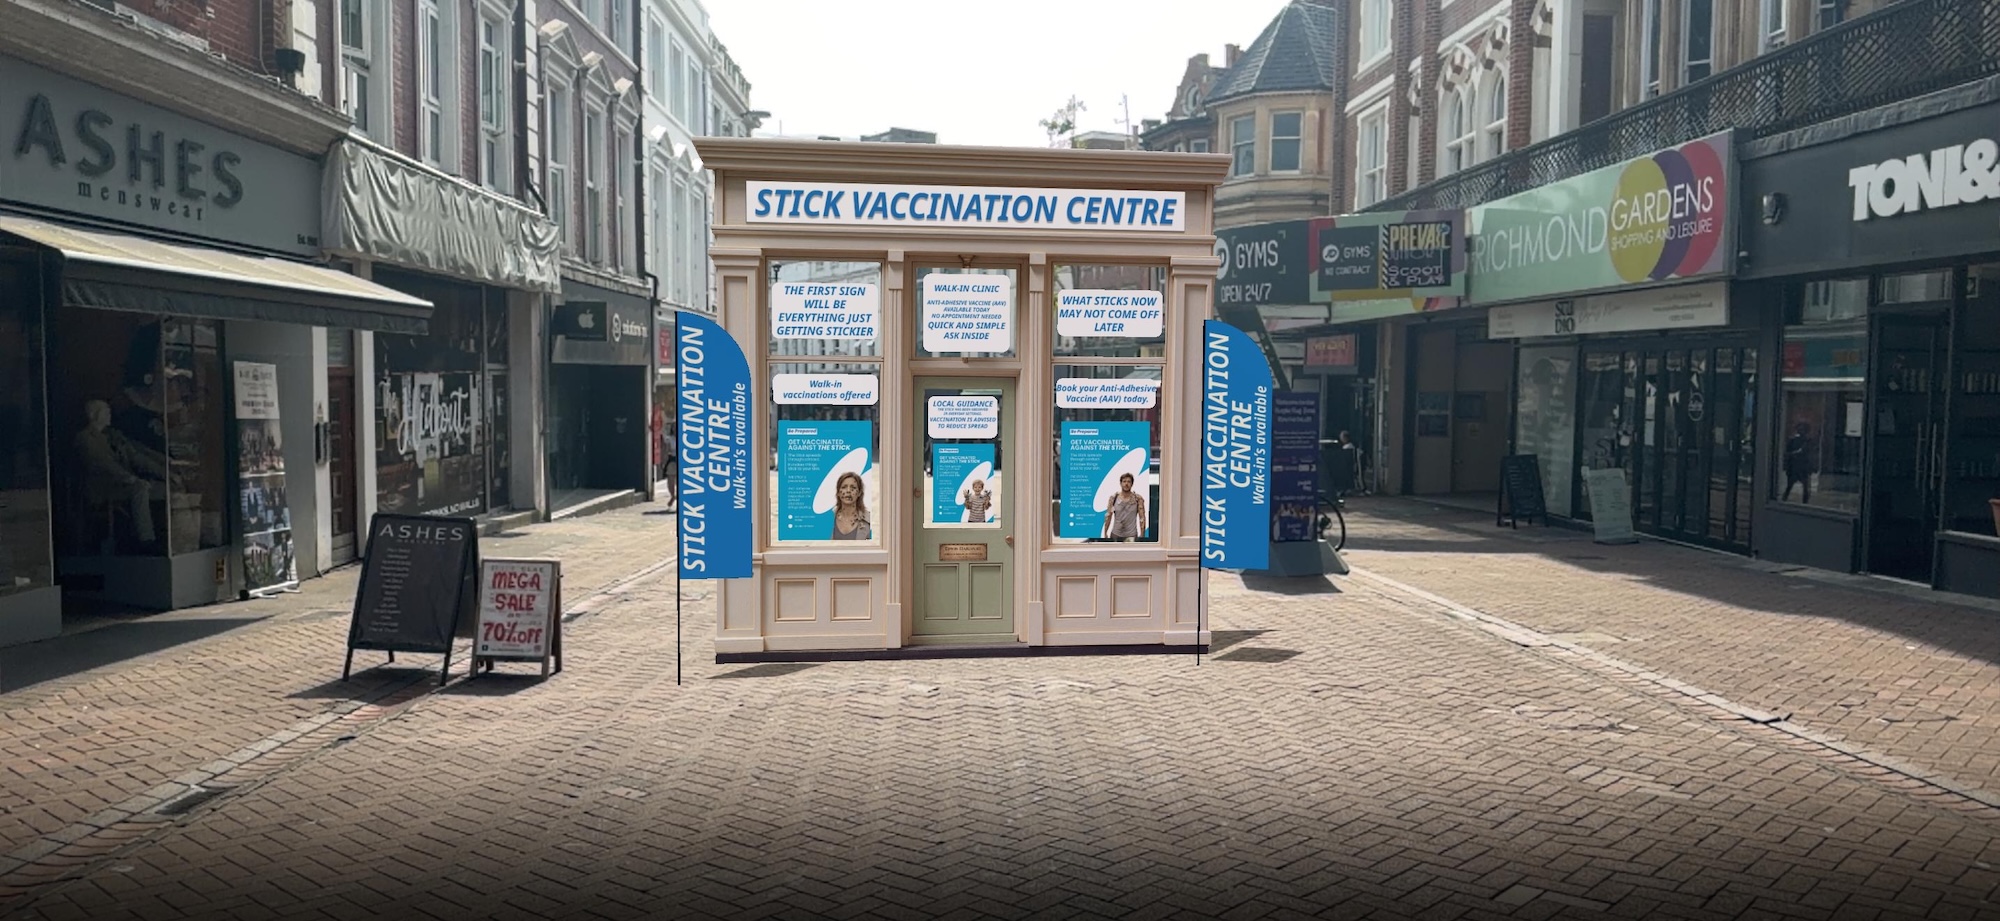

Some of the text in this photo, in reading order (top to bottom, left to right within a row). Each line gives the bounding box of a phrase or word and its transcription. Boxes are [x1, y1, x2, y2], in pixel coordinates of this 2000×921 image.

[14, 91, 244, 208] ASHES
[1849, 138, 2000, 221] TONI&
[78, 180, 203, 221] menswear
[755, 188, 1178, 226] STICK VACCINATION CENTRE
[1611, 176, 1713, 231] GARDENS
[1473, 206, 1607, 274] RICHMOND
[1611, 218, 1713, 251] SHOPPING AND LEISURE
[1235, 240, 1279, 269] GYMS
[1343, 245, 1371, 260] GYMS
[1325, 265, 1371, 276] NO CONTRACT
[934, 284, 1000, 293] WALK-IN CLINIC
[1388, 276, 1400, 286] &
[784, 286, 866, 296] THE FIRST SIGN
[1220, 283, 1272, 303] OPEN 24/7
[804, 300, 846, 309] WILL BE
[1062, 296, 1157, 306] WHAT STICKS NOW
[778, 313, 872, 324] EVERYTHING JUST
[1059, 309, 1160, 319] MAY NOT COME OFF
[777, 326, 874, 336] GETTING STICKIER
[928, 321, 954, 330] QUICK
[955, 321, 974, 329] AND
[1094, 323, 1124, 332] LATER
[809, 380, 842, 388] Walk-in
[1056, 384, 1157, 394] Book your Anti-Adhesive
[783, 391, 871, 401] vaccinations offered
[1099, 395, 1121, 404] (AAV)
[1123, 395, 1149, 404] today.
[681, 326, 706, 572] STICK VACCINATION
[707, 398, 731, 492] CENTRE
[732, 382, 747, 509] Walk-in's available
[1204, 332, 1229, 562] STICK VACCINATION
[1230, 400, 1252, 488] CENTRE
[1252, 385, 1267, 505] Walk-in's available
[379, 523, 464, 541] ASHES
[492, 571, 541, 591] MEGA
[495, 593, 536, 611] SALE
